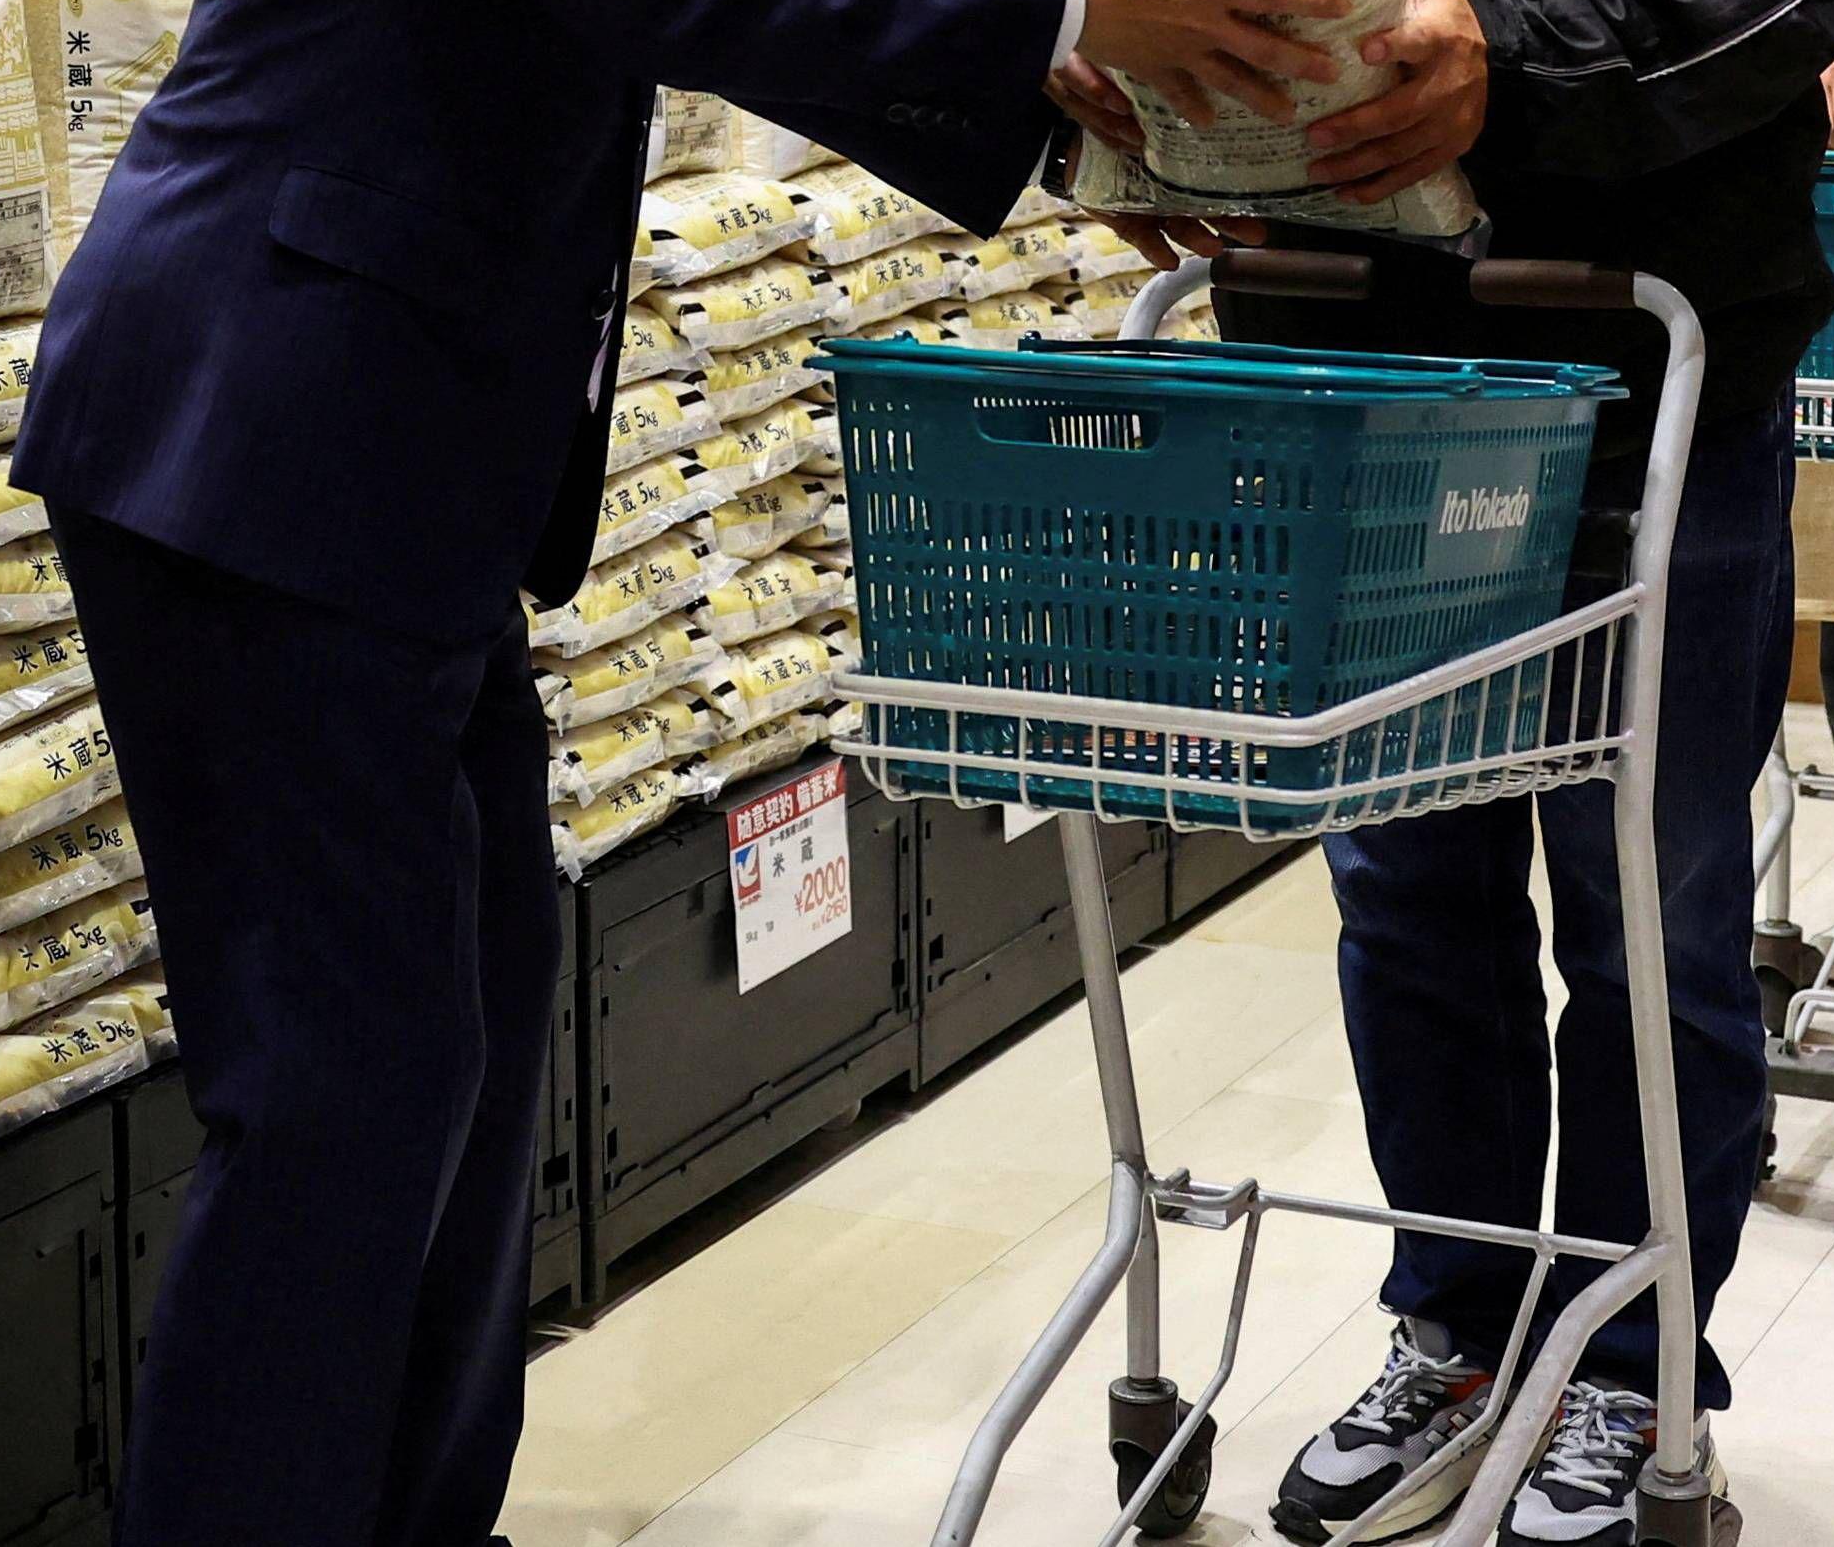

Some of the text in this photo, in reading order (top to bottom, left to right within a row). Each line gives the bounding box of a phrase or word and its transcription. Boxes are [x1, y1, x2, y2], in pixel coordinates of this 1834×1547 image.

[67, 30, 93, 88] 米蔵
[68, 99, 94, 133] 5kg
[1439, 485, 1530, 534] Ito Yokado
[13, 636, 68, 676] 米蔵
[42, 738, 94, 782] 米蔵
[84, 823, 124, 853] 5kg
[794, 855, 847, 919] ¥2000
[41, 1026, 101, 1065] 米蔵
